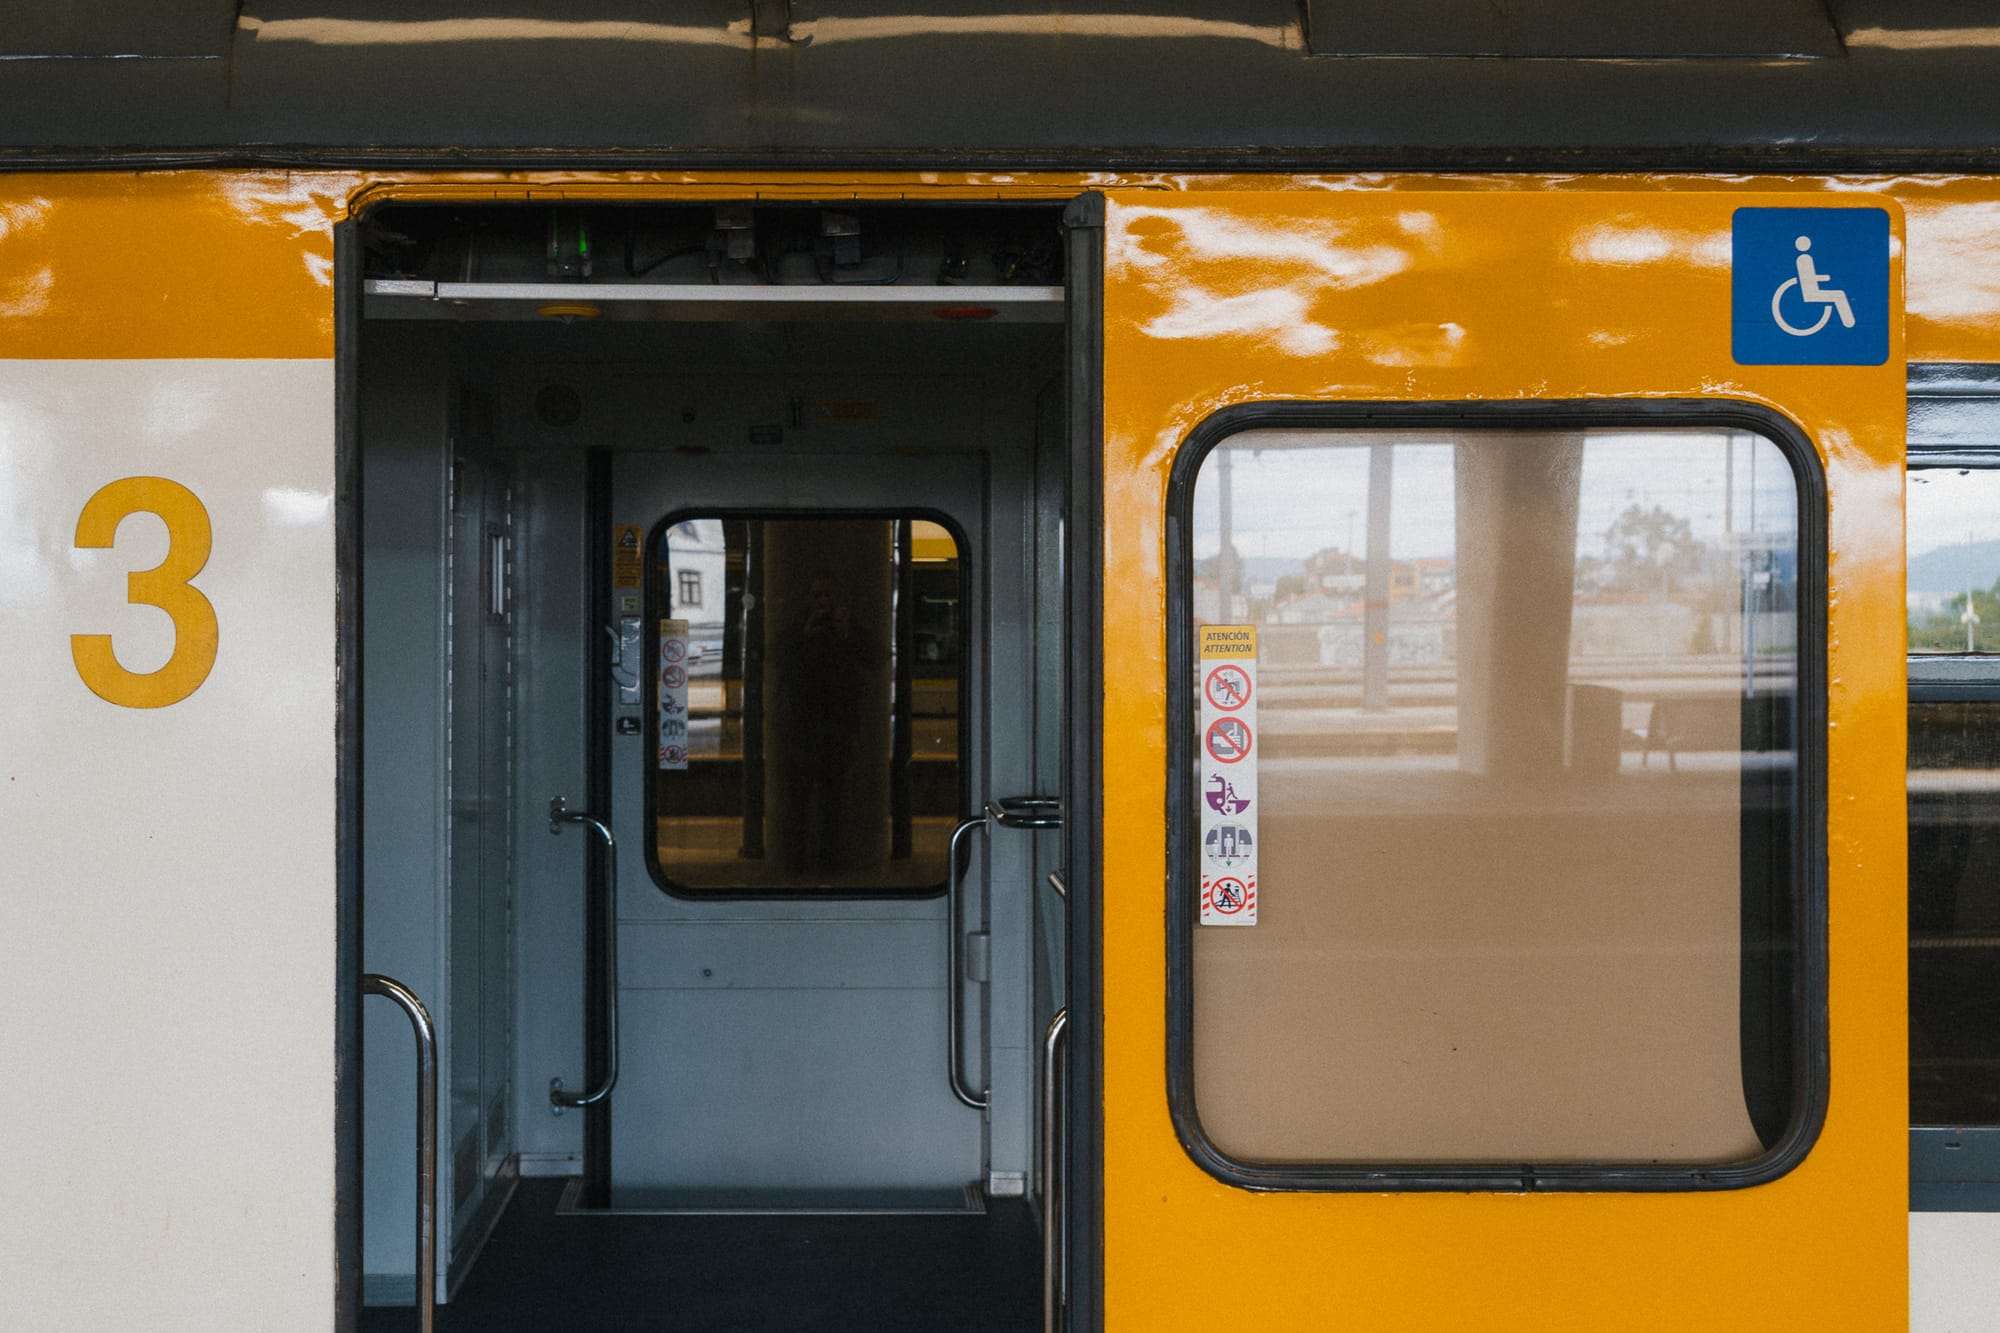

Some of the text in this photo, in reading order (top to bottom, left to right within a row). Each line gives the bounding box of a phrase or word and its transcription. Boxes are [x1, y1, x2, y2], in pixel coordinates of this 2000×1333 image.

[71, 476, 218, 708] 3
[1206, 631, 1250, 641] ATENCIÓN
[1204, 644, 1252, 653] ATTENTION
